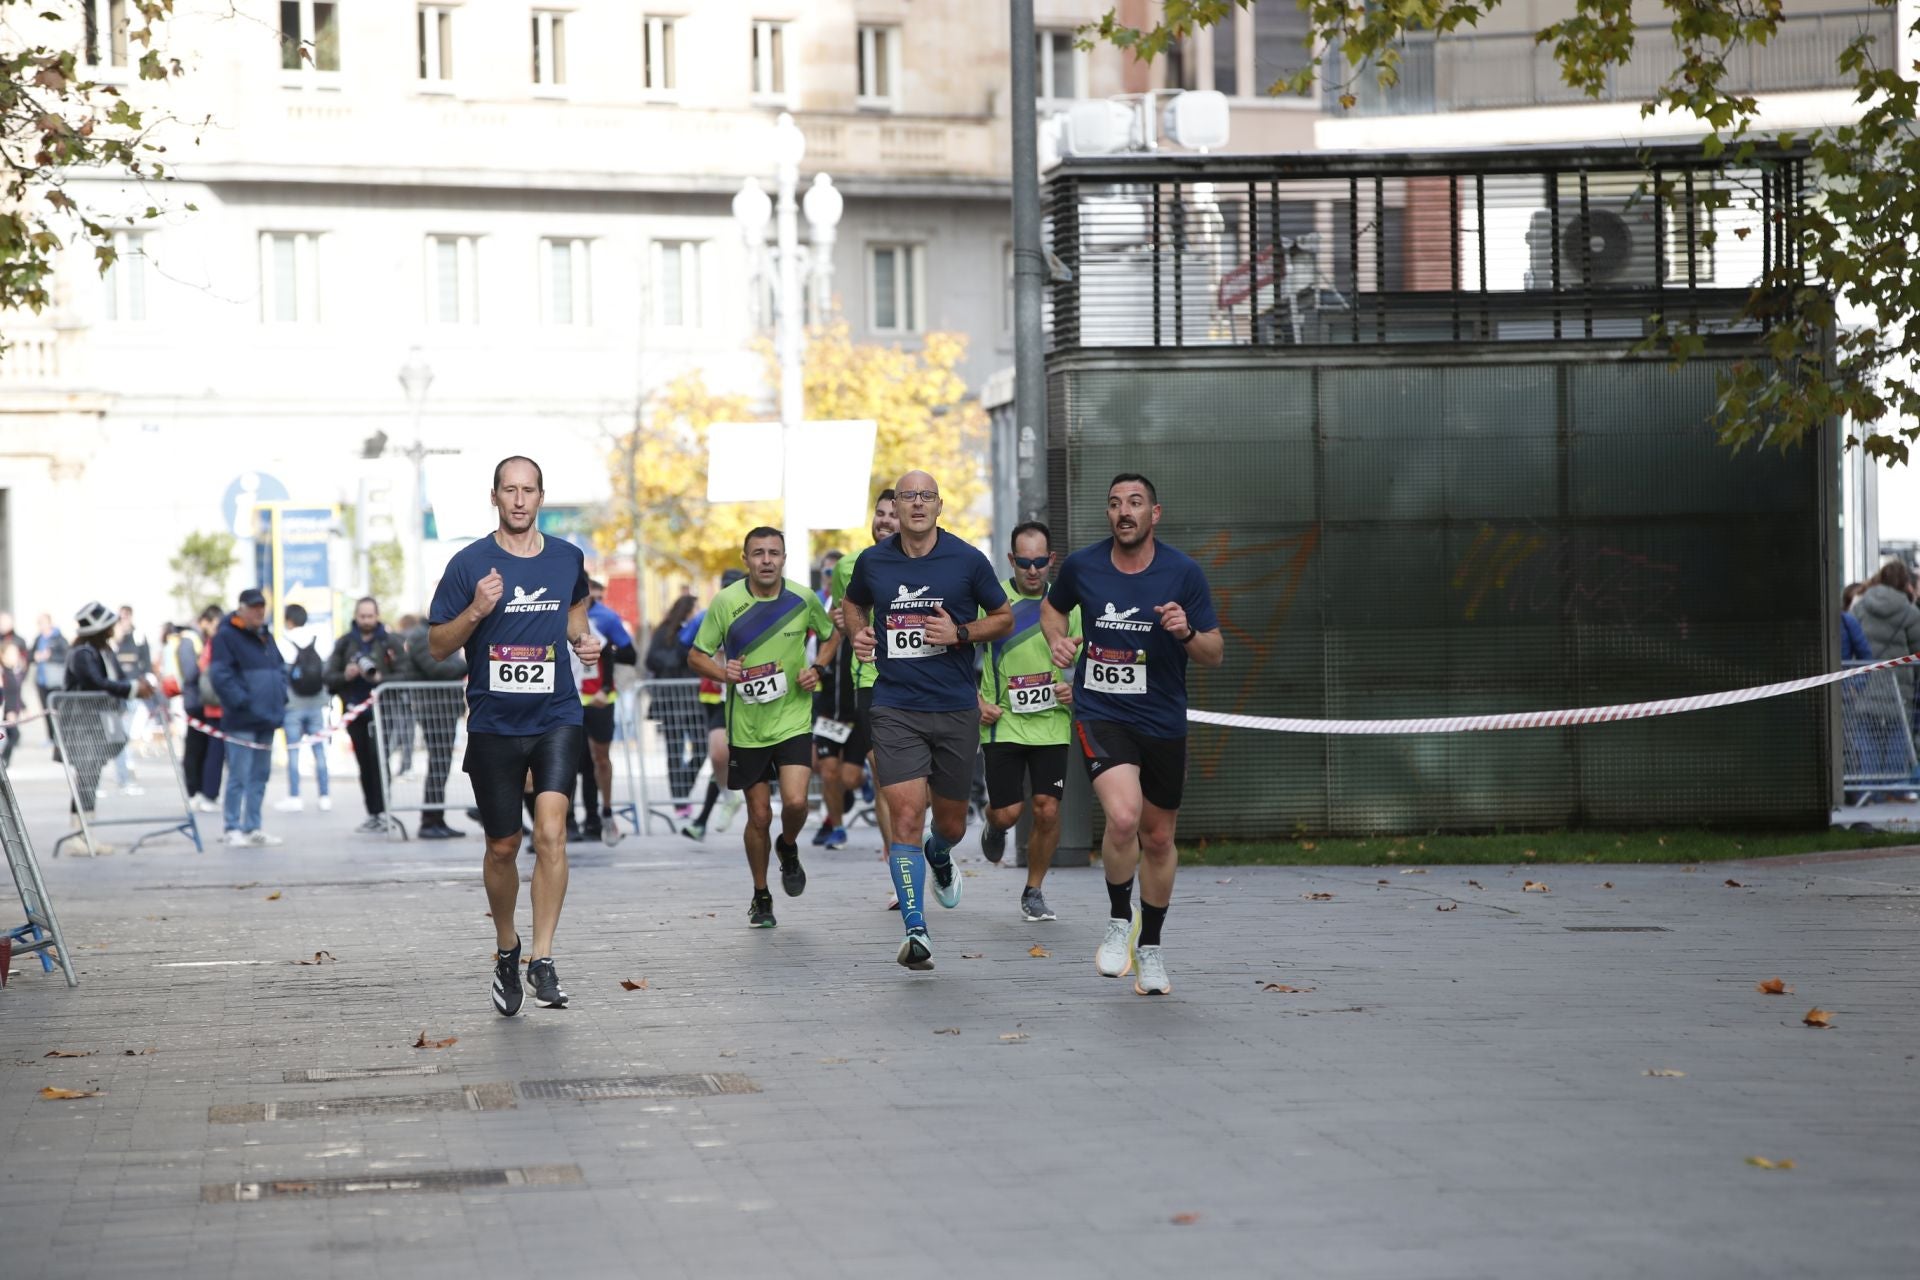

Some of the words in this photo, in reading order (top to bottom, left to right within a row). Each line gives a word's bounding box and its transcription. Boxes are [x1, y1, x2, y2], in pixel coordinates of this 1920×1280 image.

[504, 603, 559, 613] MICHELIN
[1095, 621, 1152, 632] MICHELIN
[896, 631, 936, 649] 66
[499, 663, 544, 683] 662
[1093, 663, 1135, 684] 663
[743, 677, 778, 697] 921
[1016, 687, 1051, 705] 920
